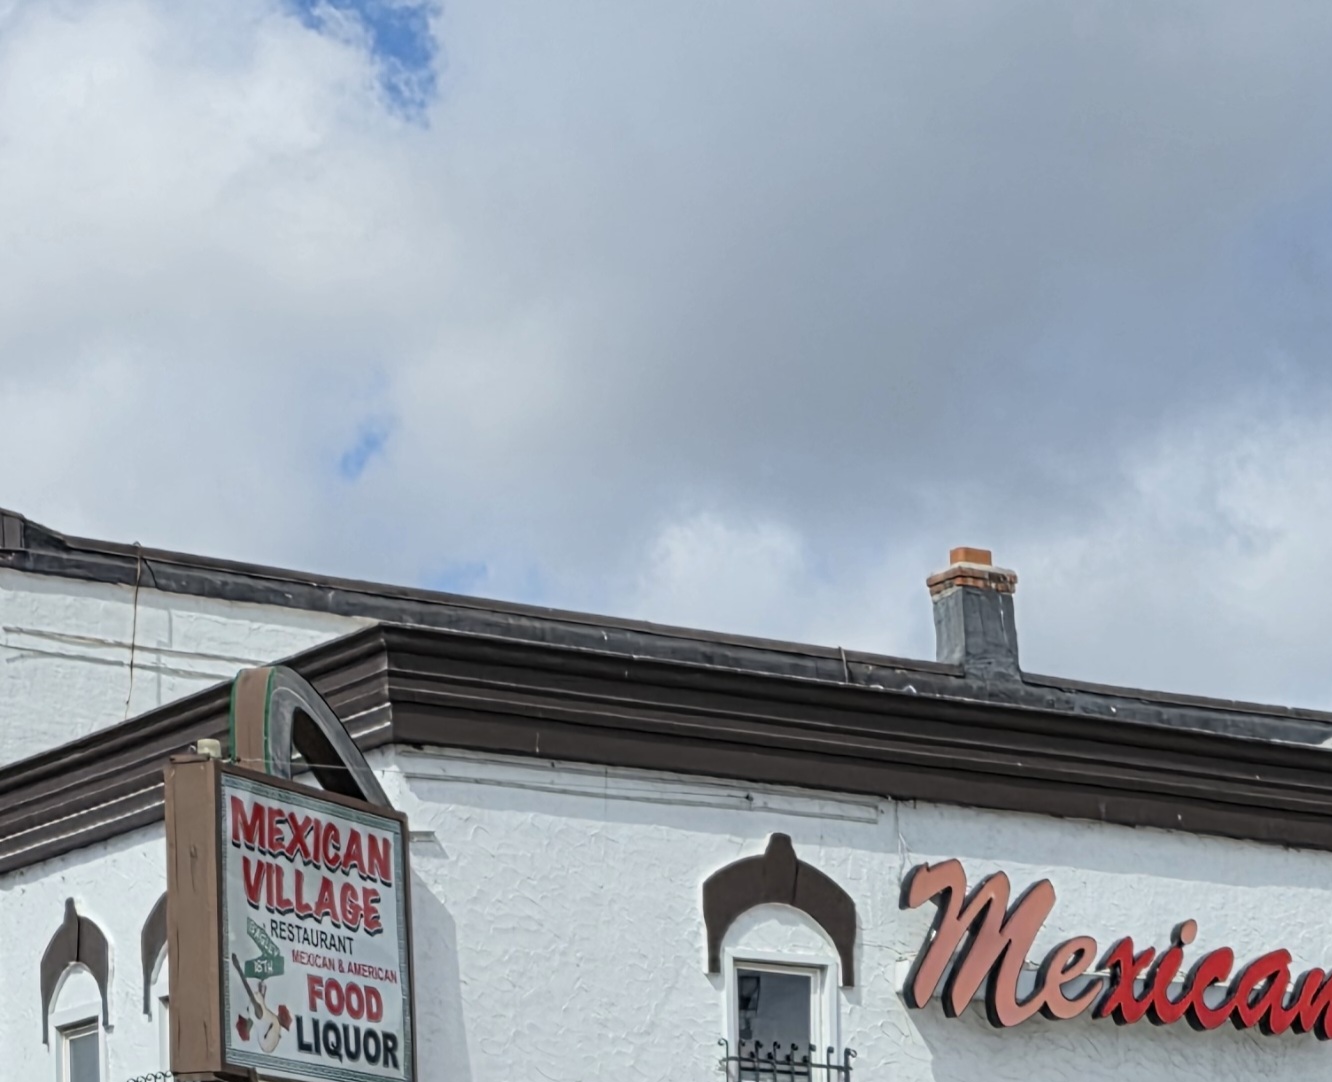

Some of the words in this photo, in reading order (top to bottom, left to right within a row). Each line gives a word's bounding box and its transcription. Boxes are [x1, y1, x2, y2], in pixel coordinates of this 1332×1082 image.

[230, 795, 392, 887] MEXICAN
[242, 855, 384, 937] VILLAGE
[270, 918, 354, 956] RESTAURANT
[292, 949, 336, 972] MEXICAN
[338, 958, 345, 974] &
[347, 961, 398, 984] AMERICAN
[306, 973, 384, 1024] FOOD
[295, 1013, 400, 1070] LIQUOR
